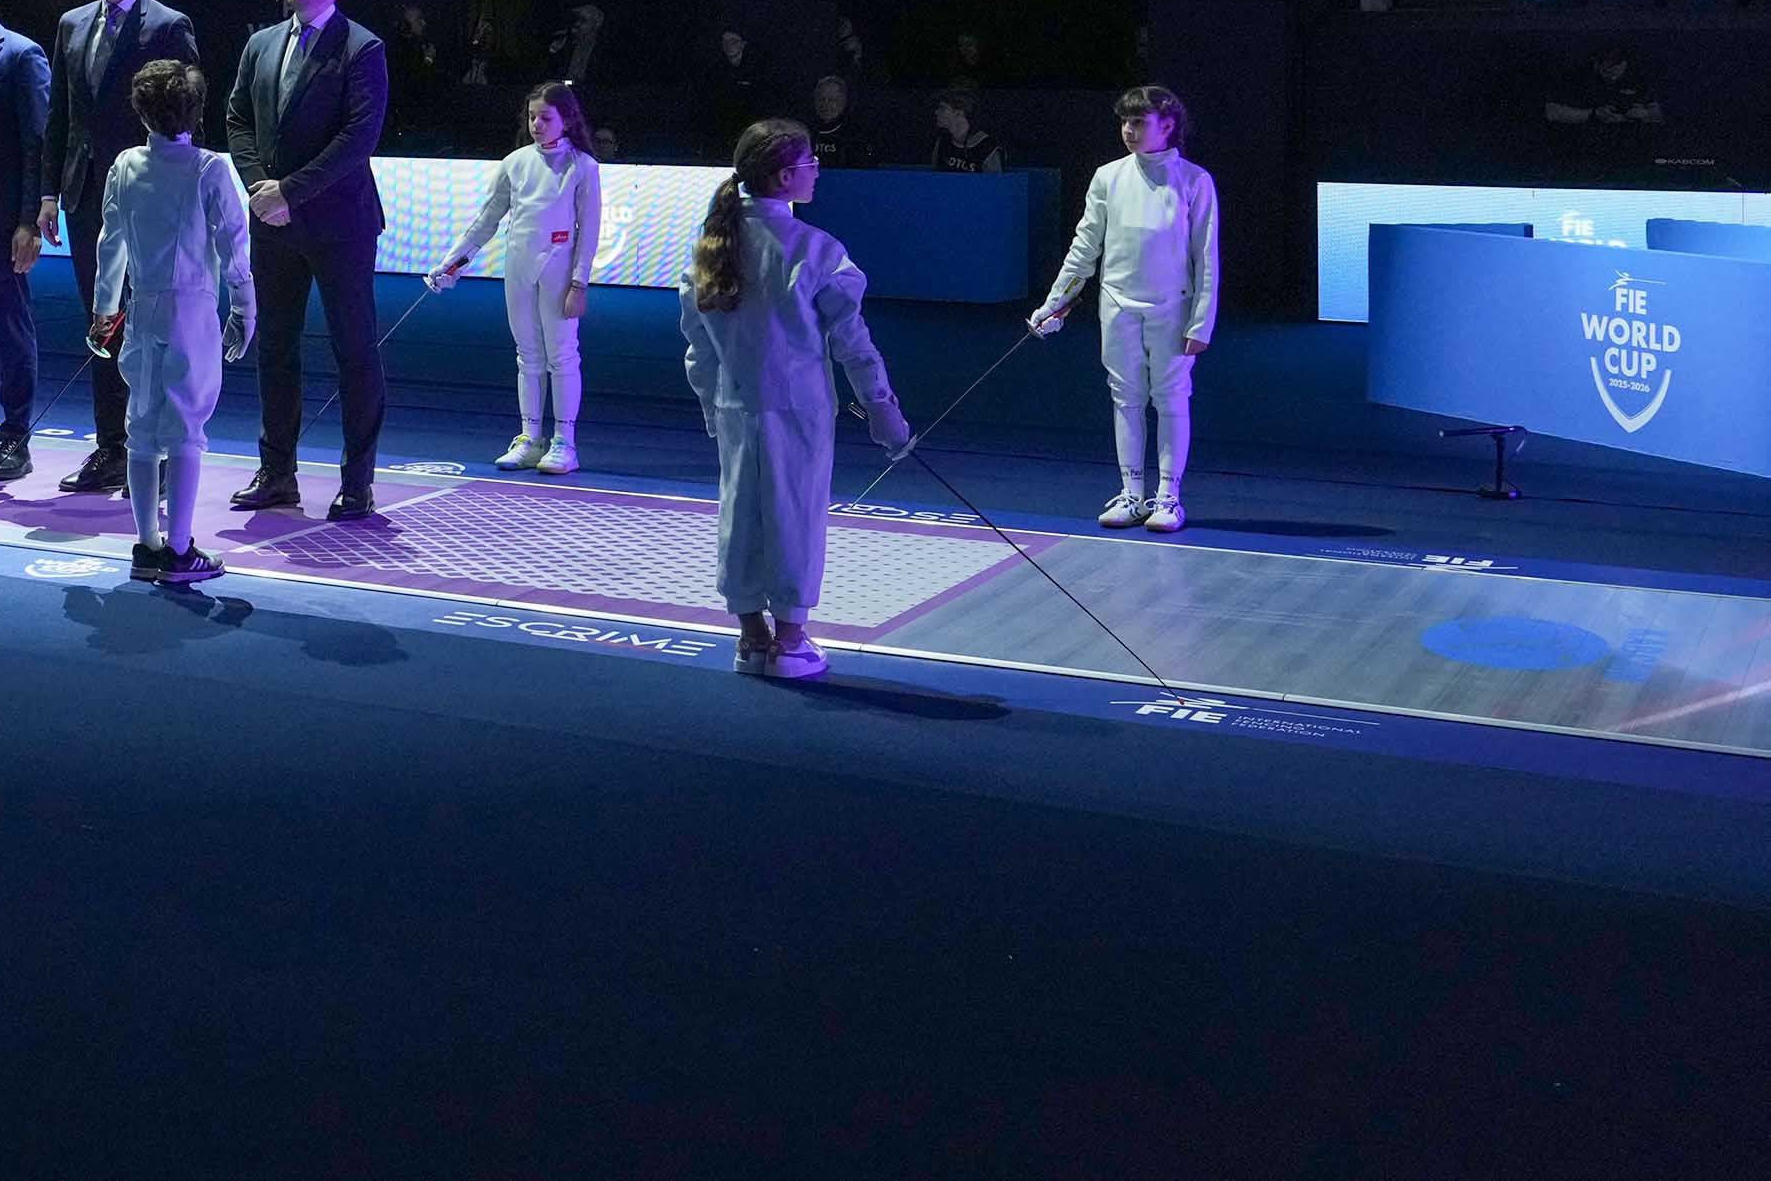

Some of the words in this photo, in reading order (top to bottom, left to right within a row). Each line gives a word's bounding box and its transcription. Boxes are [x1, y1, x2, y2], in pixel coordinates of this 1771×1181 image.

[1615, 287, 1648, 315] FIE
[1581, 312, 1681, 353] WORLD
[1604, 346, 1658, 379] CUP
[432, 611, 717, 656] ESCRIME
[1134, 704, 1228, 724] FIE
